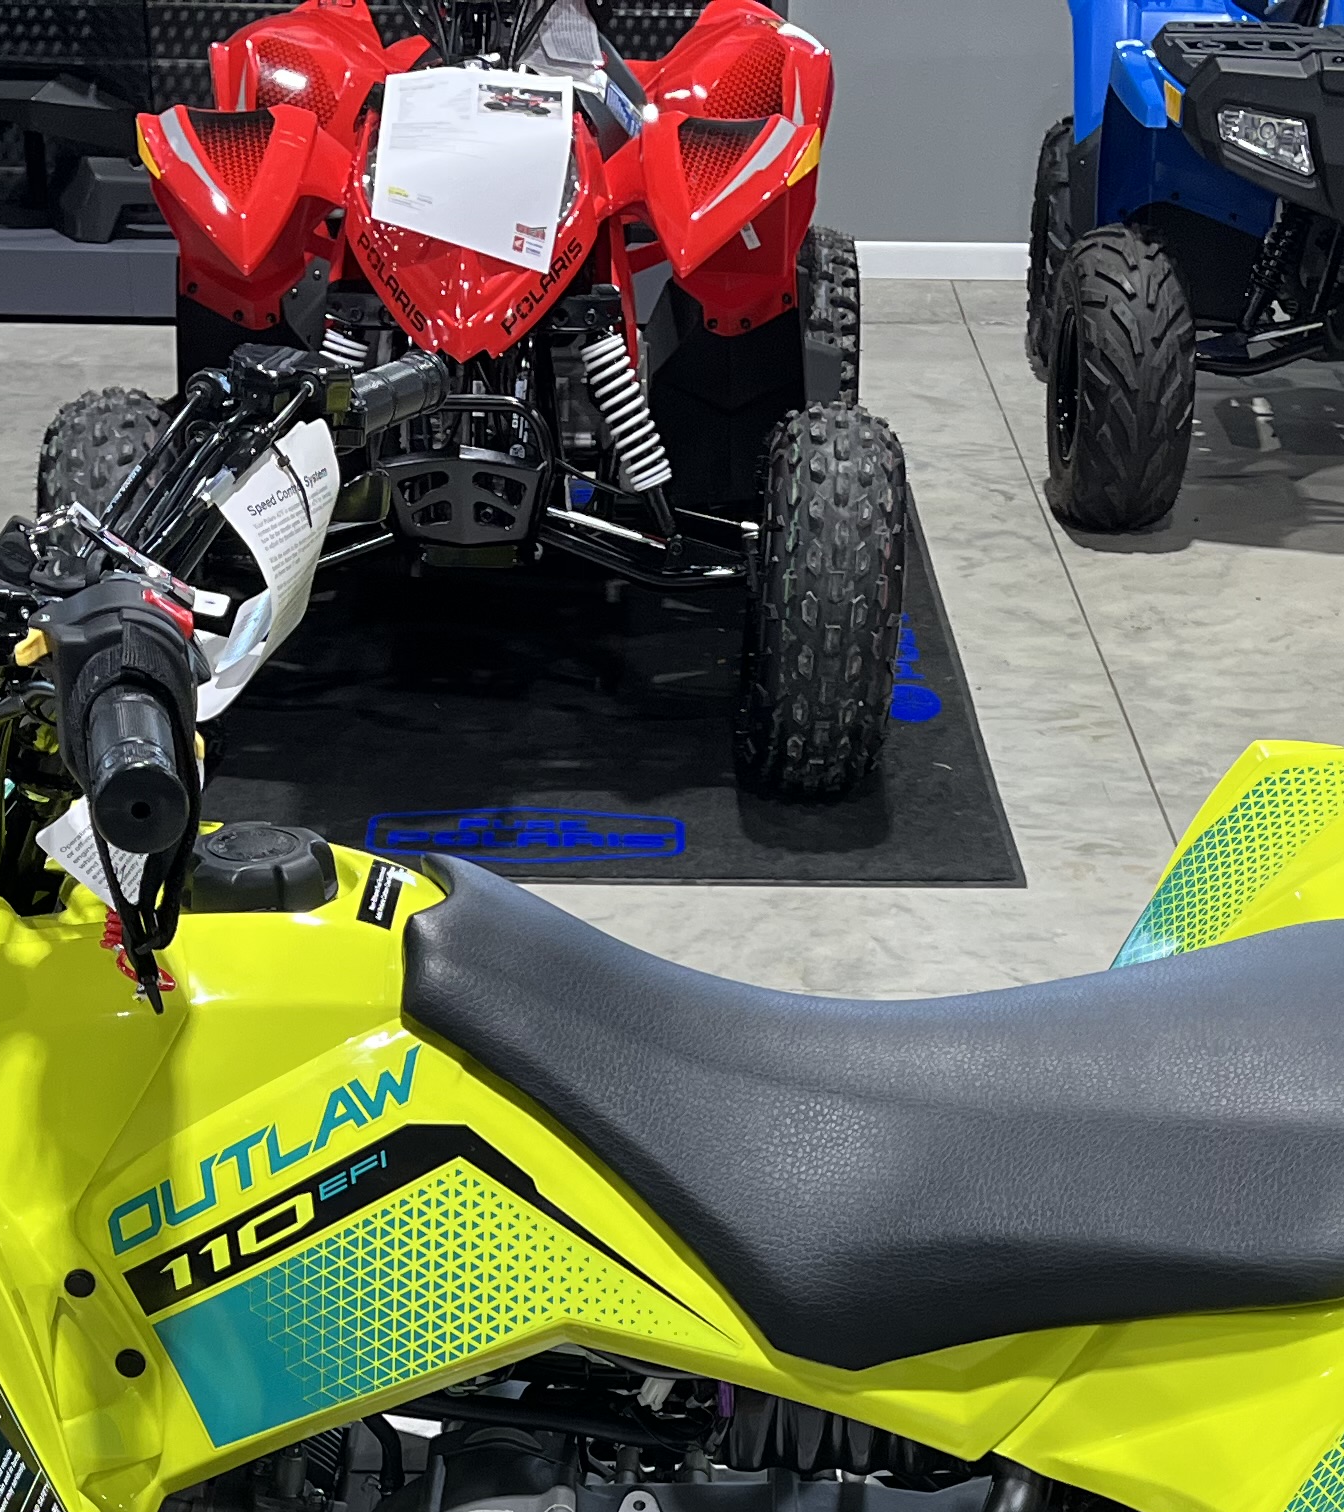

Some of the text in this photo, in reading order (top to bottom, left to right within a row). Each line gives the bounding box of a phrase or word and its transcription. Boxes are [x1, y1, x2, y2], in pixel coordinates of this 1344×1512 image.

[357, 232, 426, 333] POLARIS
[500, 237, 583, 335] POLARIS
[247, 466, 328, 518] Speed Contro System
[387, 829, 675, 848] POLARIS
[107, 1044, 422, 1257] OUTLAW
[160, 1150, 388, 1291] 110 EFI
